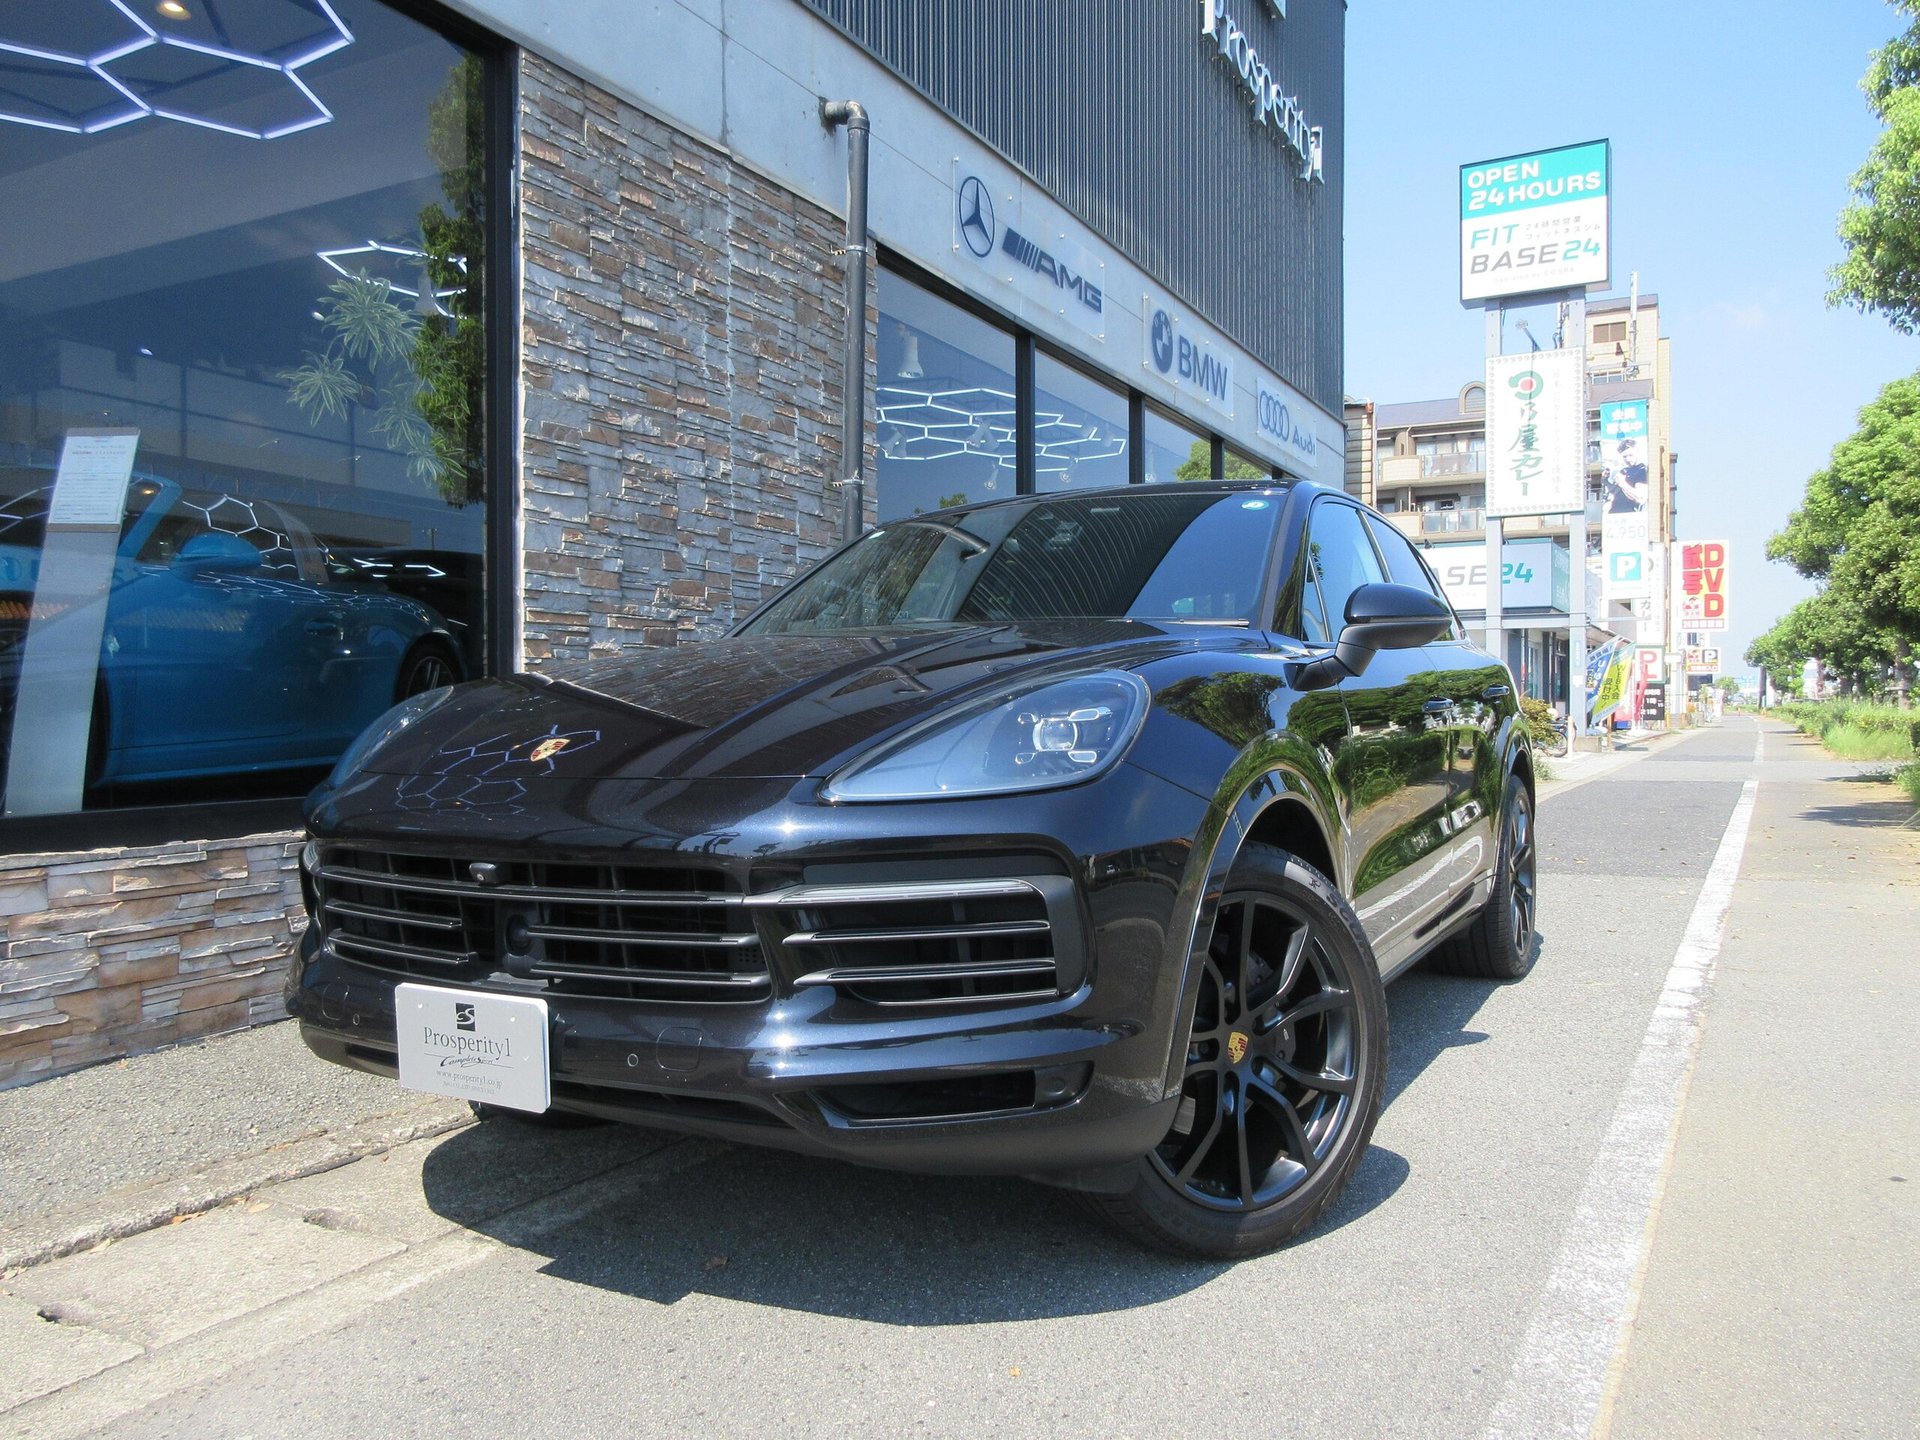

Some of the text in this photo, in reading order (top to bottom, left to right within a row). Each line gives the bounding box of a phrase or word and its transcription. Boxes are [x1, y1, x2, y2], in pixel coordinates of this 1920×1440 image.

[1467, 159, 1539, 189] OPEN
[1468, 171, 1601, 211] 24 HOURS
[1470, 223, 1520, 250] FIT
[1179, 334, 1228, 401] BMW
[1292, 425, 1316, 457] Audi
[1616, 555, 1636, 579] P
[1704, 543, 1724, 618] DVD
